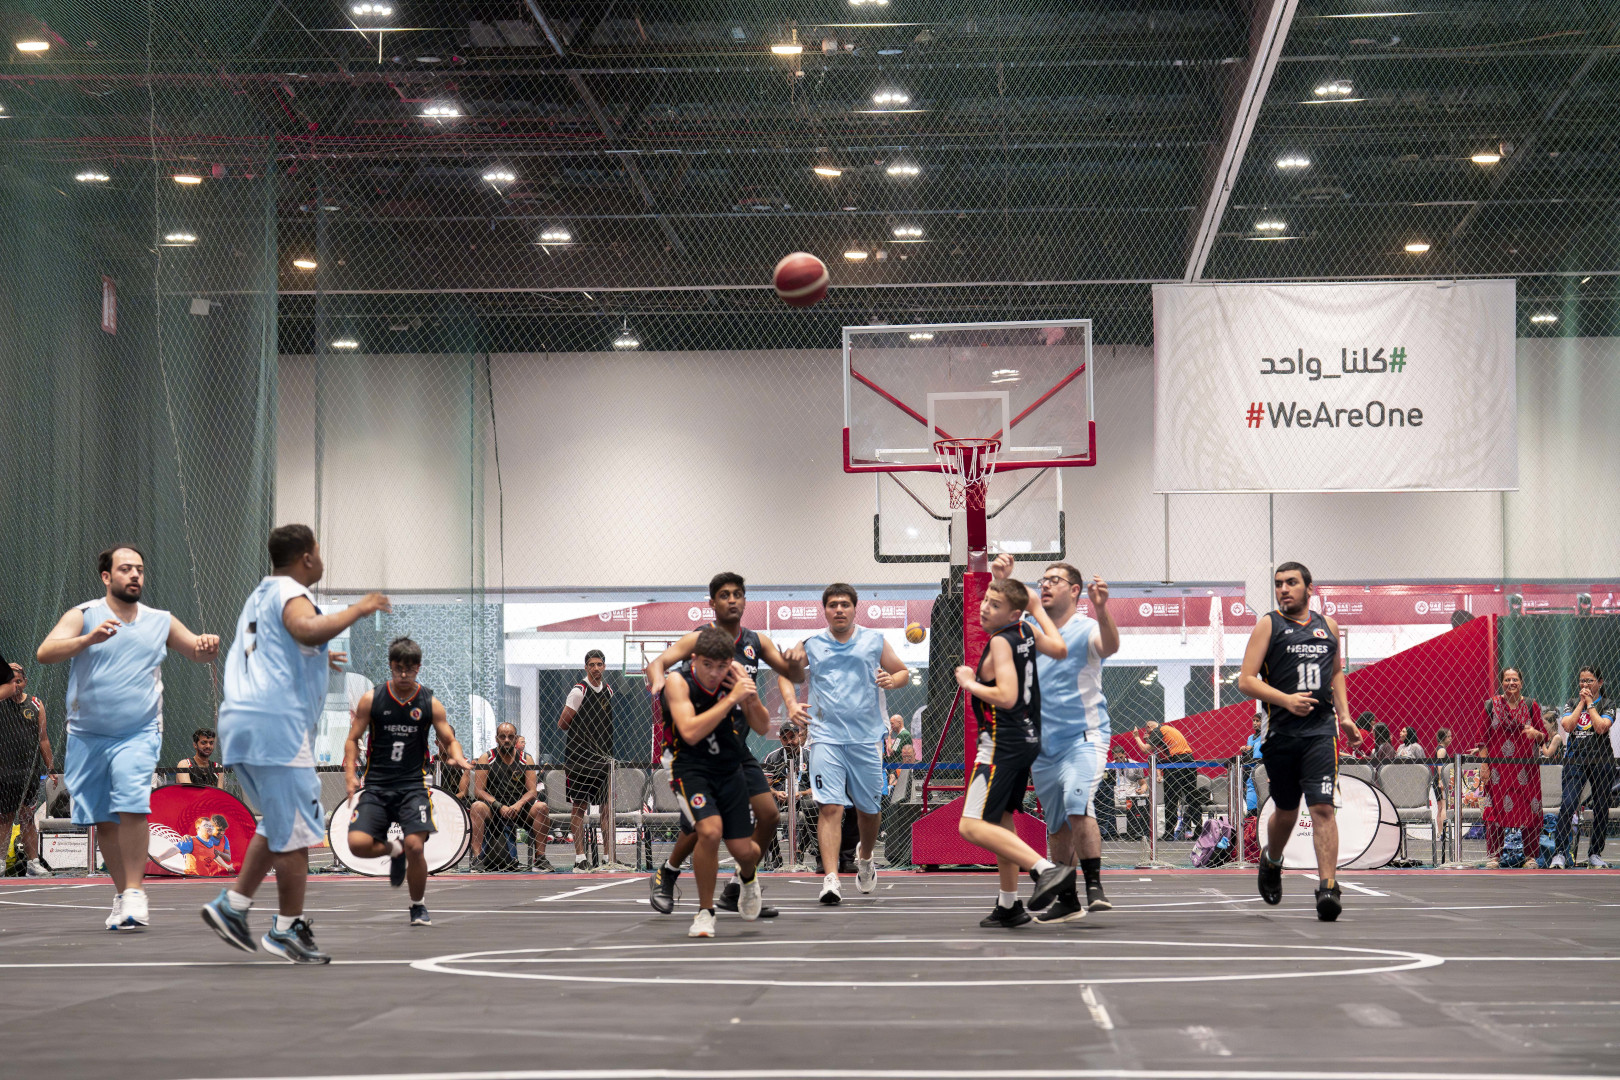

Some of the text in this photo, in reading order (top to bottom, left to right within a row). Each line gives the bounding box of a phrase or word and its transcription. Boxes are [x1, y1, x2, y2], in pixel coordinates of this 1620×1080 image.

[1260, 347, 1407, 381] #كلنا_واحد
[1246, 401, 1424, 428] #WeAreOne
[1286, 644, 1329, 653] HEROES
[1297, 663, 1321, 690] 10
[384, 724, 418, 733] HEROES
[391, 741, 405, 762] 8
[815, 774, 823, 790] 6
[1321, 782, 1333, 795] 10
